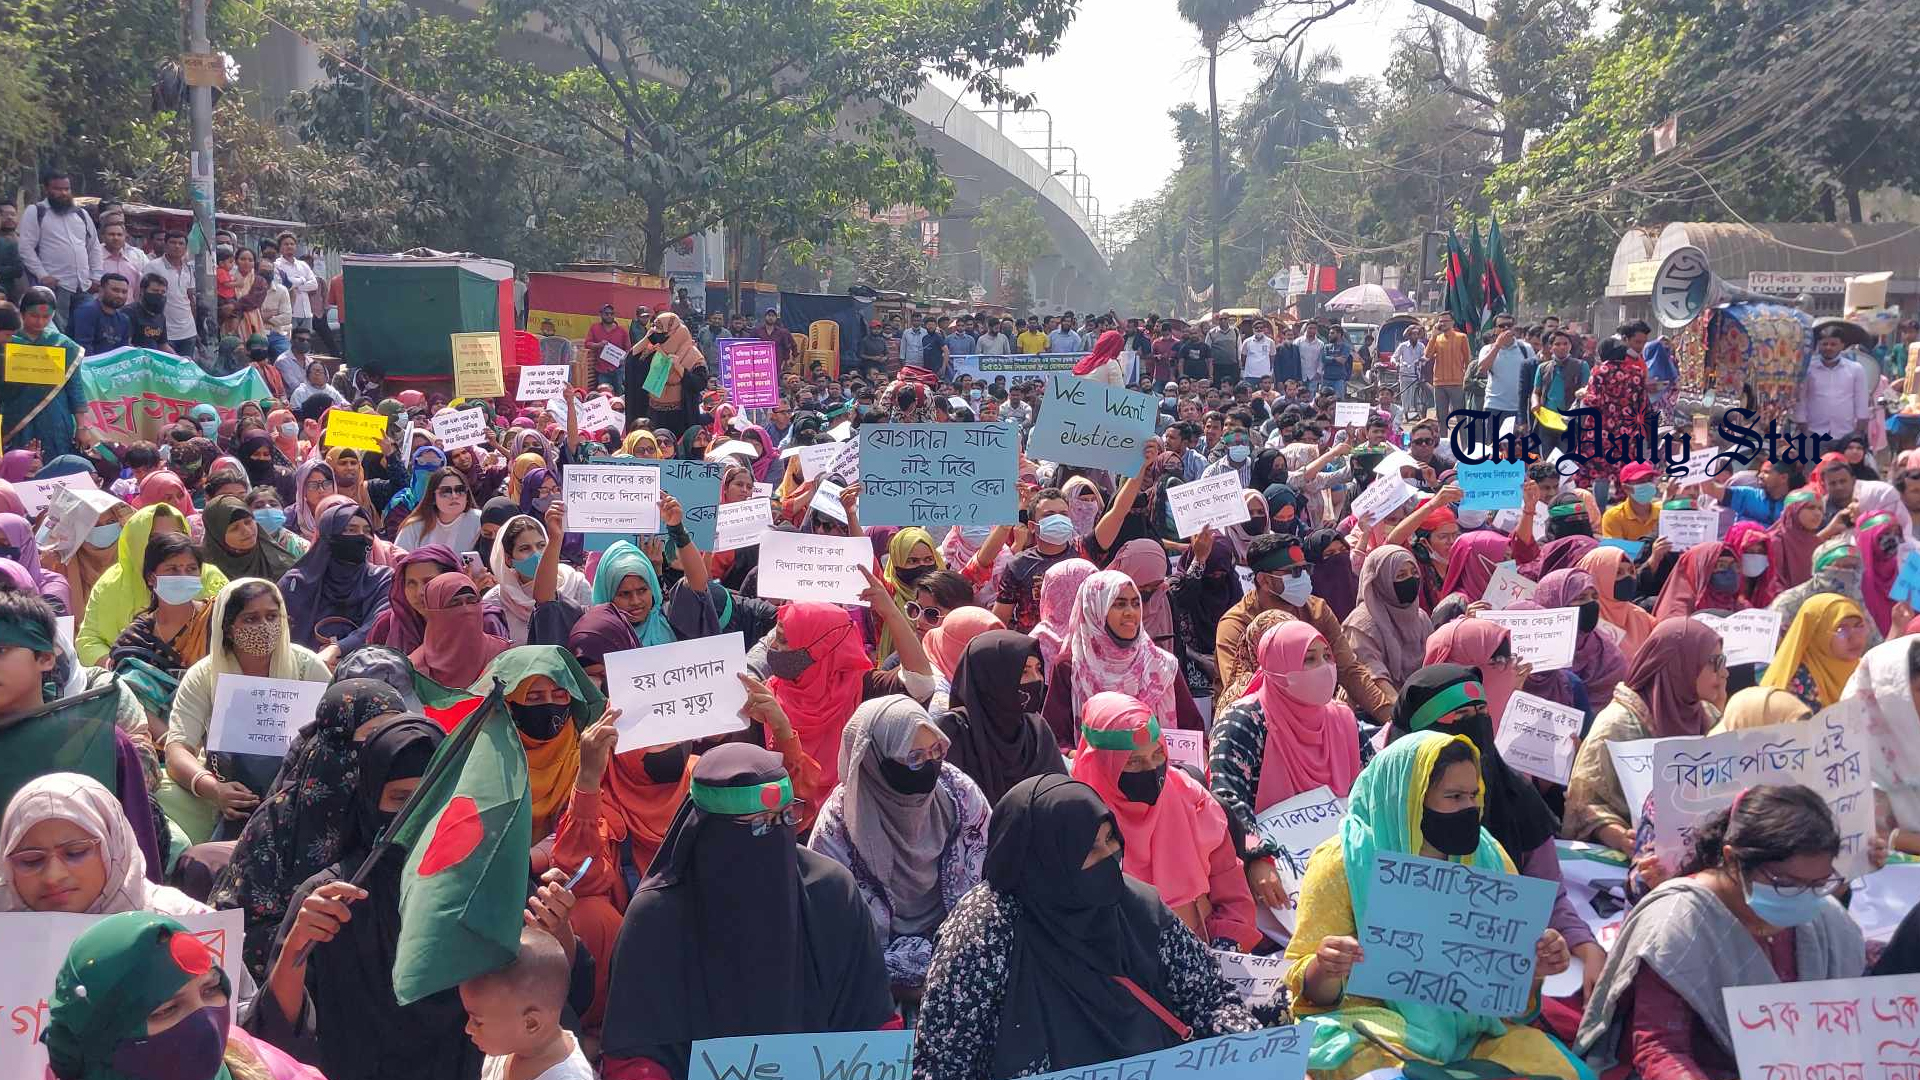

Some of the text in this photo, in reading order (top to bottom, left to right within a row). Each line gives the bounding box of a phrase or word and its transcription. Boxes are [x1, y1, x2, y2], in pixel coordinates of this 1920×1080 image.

[1752, 286, 1846, 294] TICKET COU
[1053, 374, 1086, 406] We
[1104, 388, 1146, 422] Want
[867, 425, 1009, 450] যোগদান যদি
[1060, 421, 1135, 449] Justice
[665, 460, 702, 480] যদি
[900, 454, 976, 477] নাই দিবে
[569, 473, 655, 486] আমার বোনের রক্ত
[971, 478, 1005, 497] কেন
[569, 489, 654, 503] বৃথা যেতে দিবোনা
[686, 504, 717, 522] কেন
[845, 565, 860, 573] কে
[631, 659, 725, 691] হয় যোগদান
[250, 689, 266, 698] এক
[651, 692, 714, 718] নয় মৃত্যু
[1178, 739, 1197, 751] কে?
[1814, 716, 1848, 759] এই
[1823, 751, 1861, 788] রায়
[1441, 940, 1532, 981] করতে
[1387, 969, 1485, 1014] পারছি
[1737, 996, 1920, 1036] এক দফা এক
[701, 1043, 914, 1080] We Want
